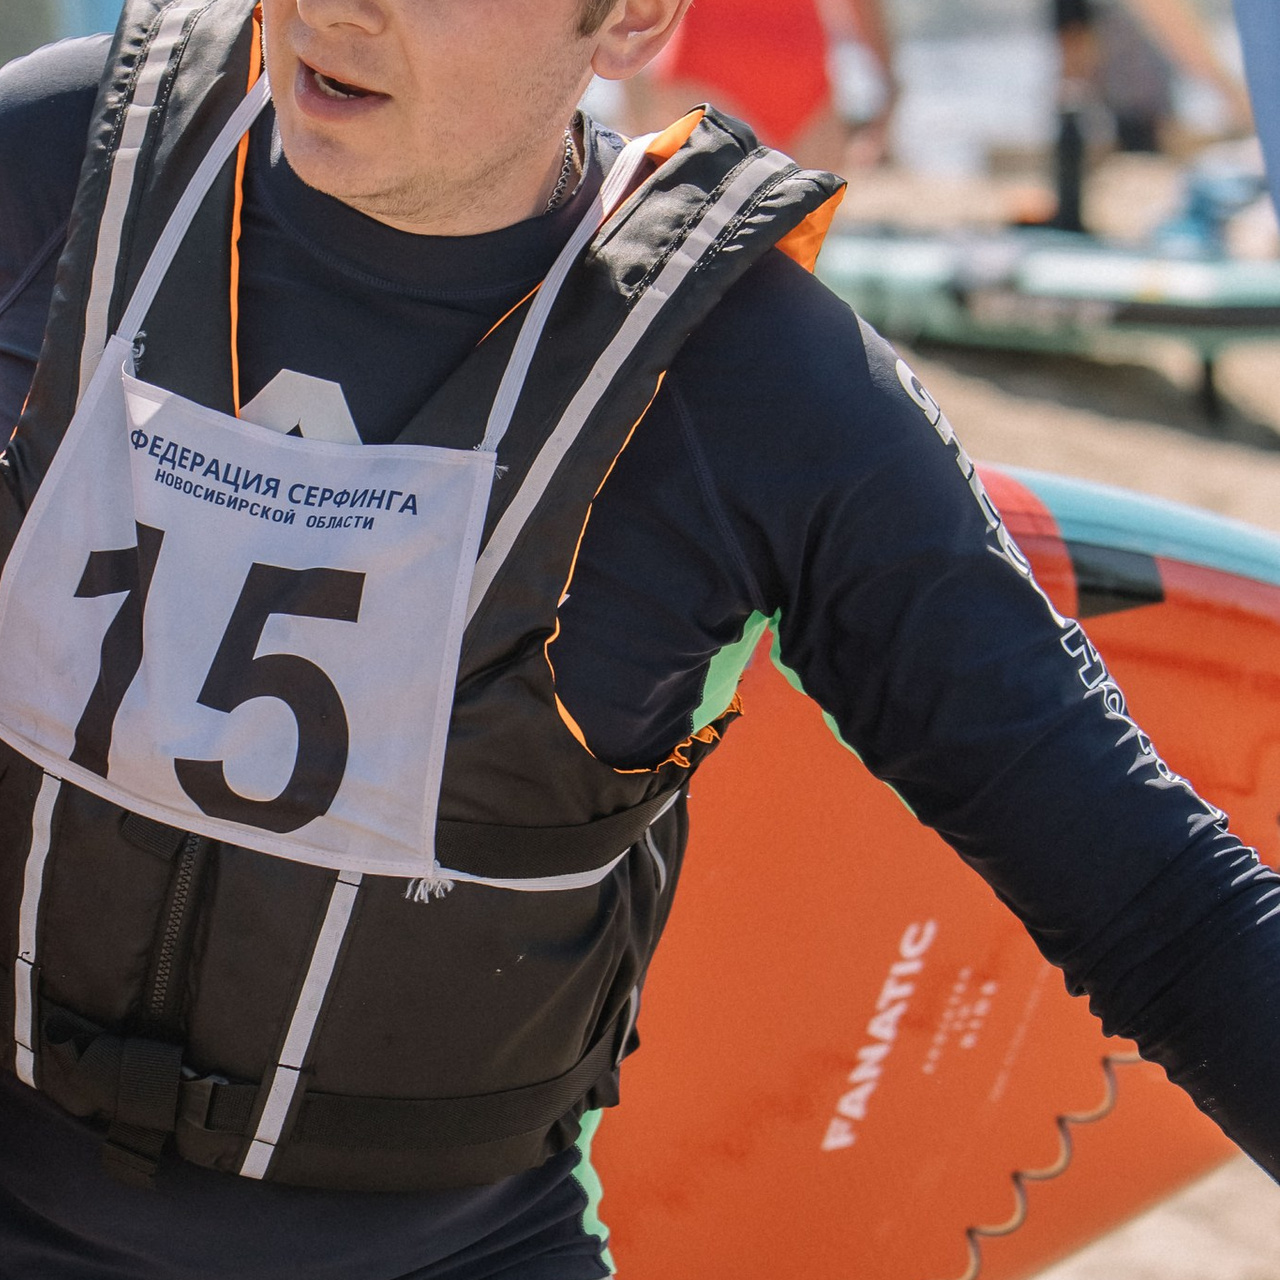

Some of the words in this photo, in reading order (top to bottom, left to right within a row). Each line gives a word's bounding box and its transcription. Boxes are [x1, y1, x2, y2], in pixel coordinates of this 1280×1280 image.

[130, 428, 281, 499] ФЕДЕРАЦИЯ
[288, 483, 419, 516] СЕРФИНГА
[154, 468, 296, 525] НОВОСИБИРСКОЙ
[306, 515, 375, 530] ОБЛАСТИ
[69, 521, 366, 834] 15
[821, 919, 938, 1152] FANATIC
